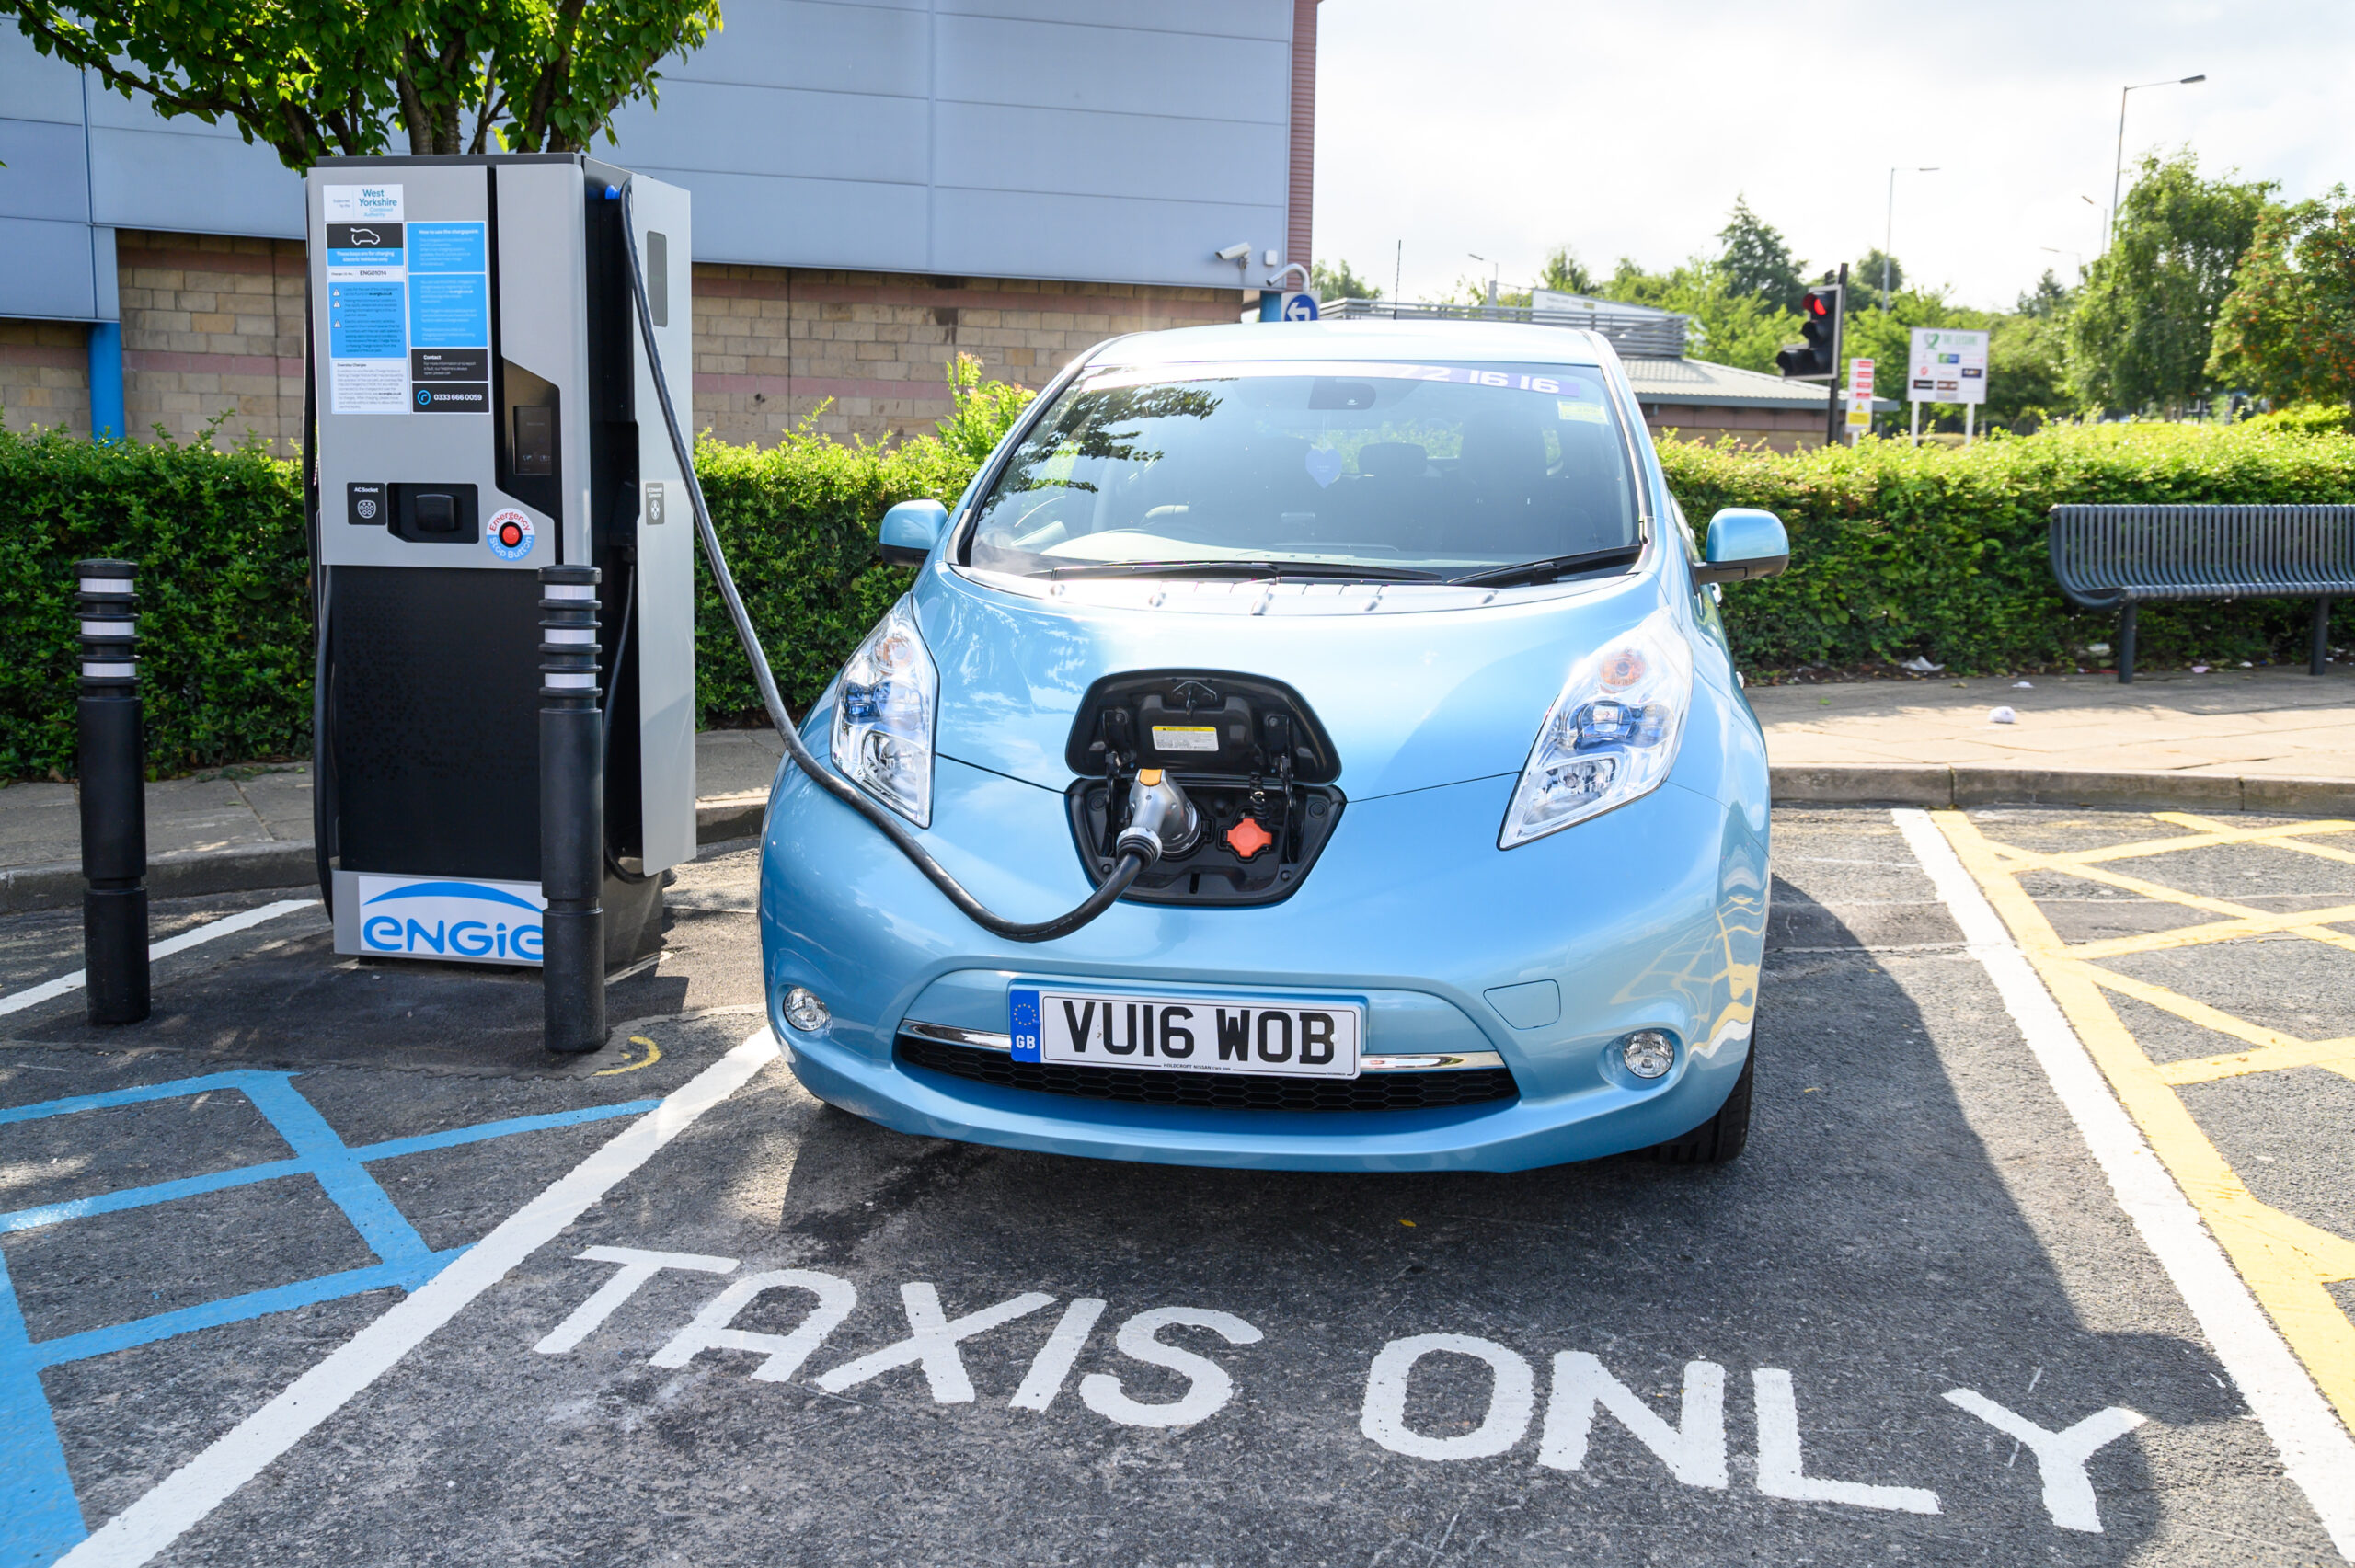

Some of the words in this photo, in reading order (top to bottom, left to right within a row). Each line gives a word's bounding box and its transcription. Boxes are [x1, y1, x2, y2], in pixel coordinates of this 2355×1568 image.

[359, 197, 397, 207] Yorkshire
[362, 189, 385, 198] West
[1468, 370, 1509, 387] 16
[1519, 375, 1560, 394] 16
[488, 511, 531, 532] Emergency
[489, 536, 507, 558] Stop
[508, 536, 533, 559] Button
[1016, 1035, 1036, 1049] GB
[1063, 1000, 1194, 1059] VU16
[1216, 1008, 1336, 1066] WOB
[534, 1245, 1264, 1428] TAXIS
[1361, 1333, 2147, 1534] ONLY
